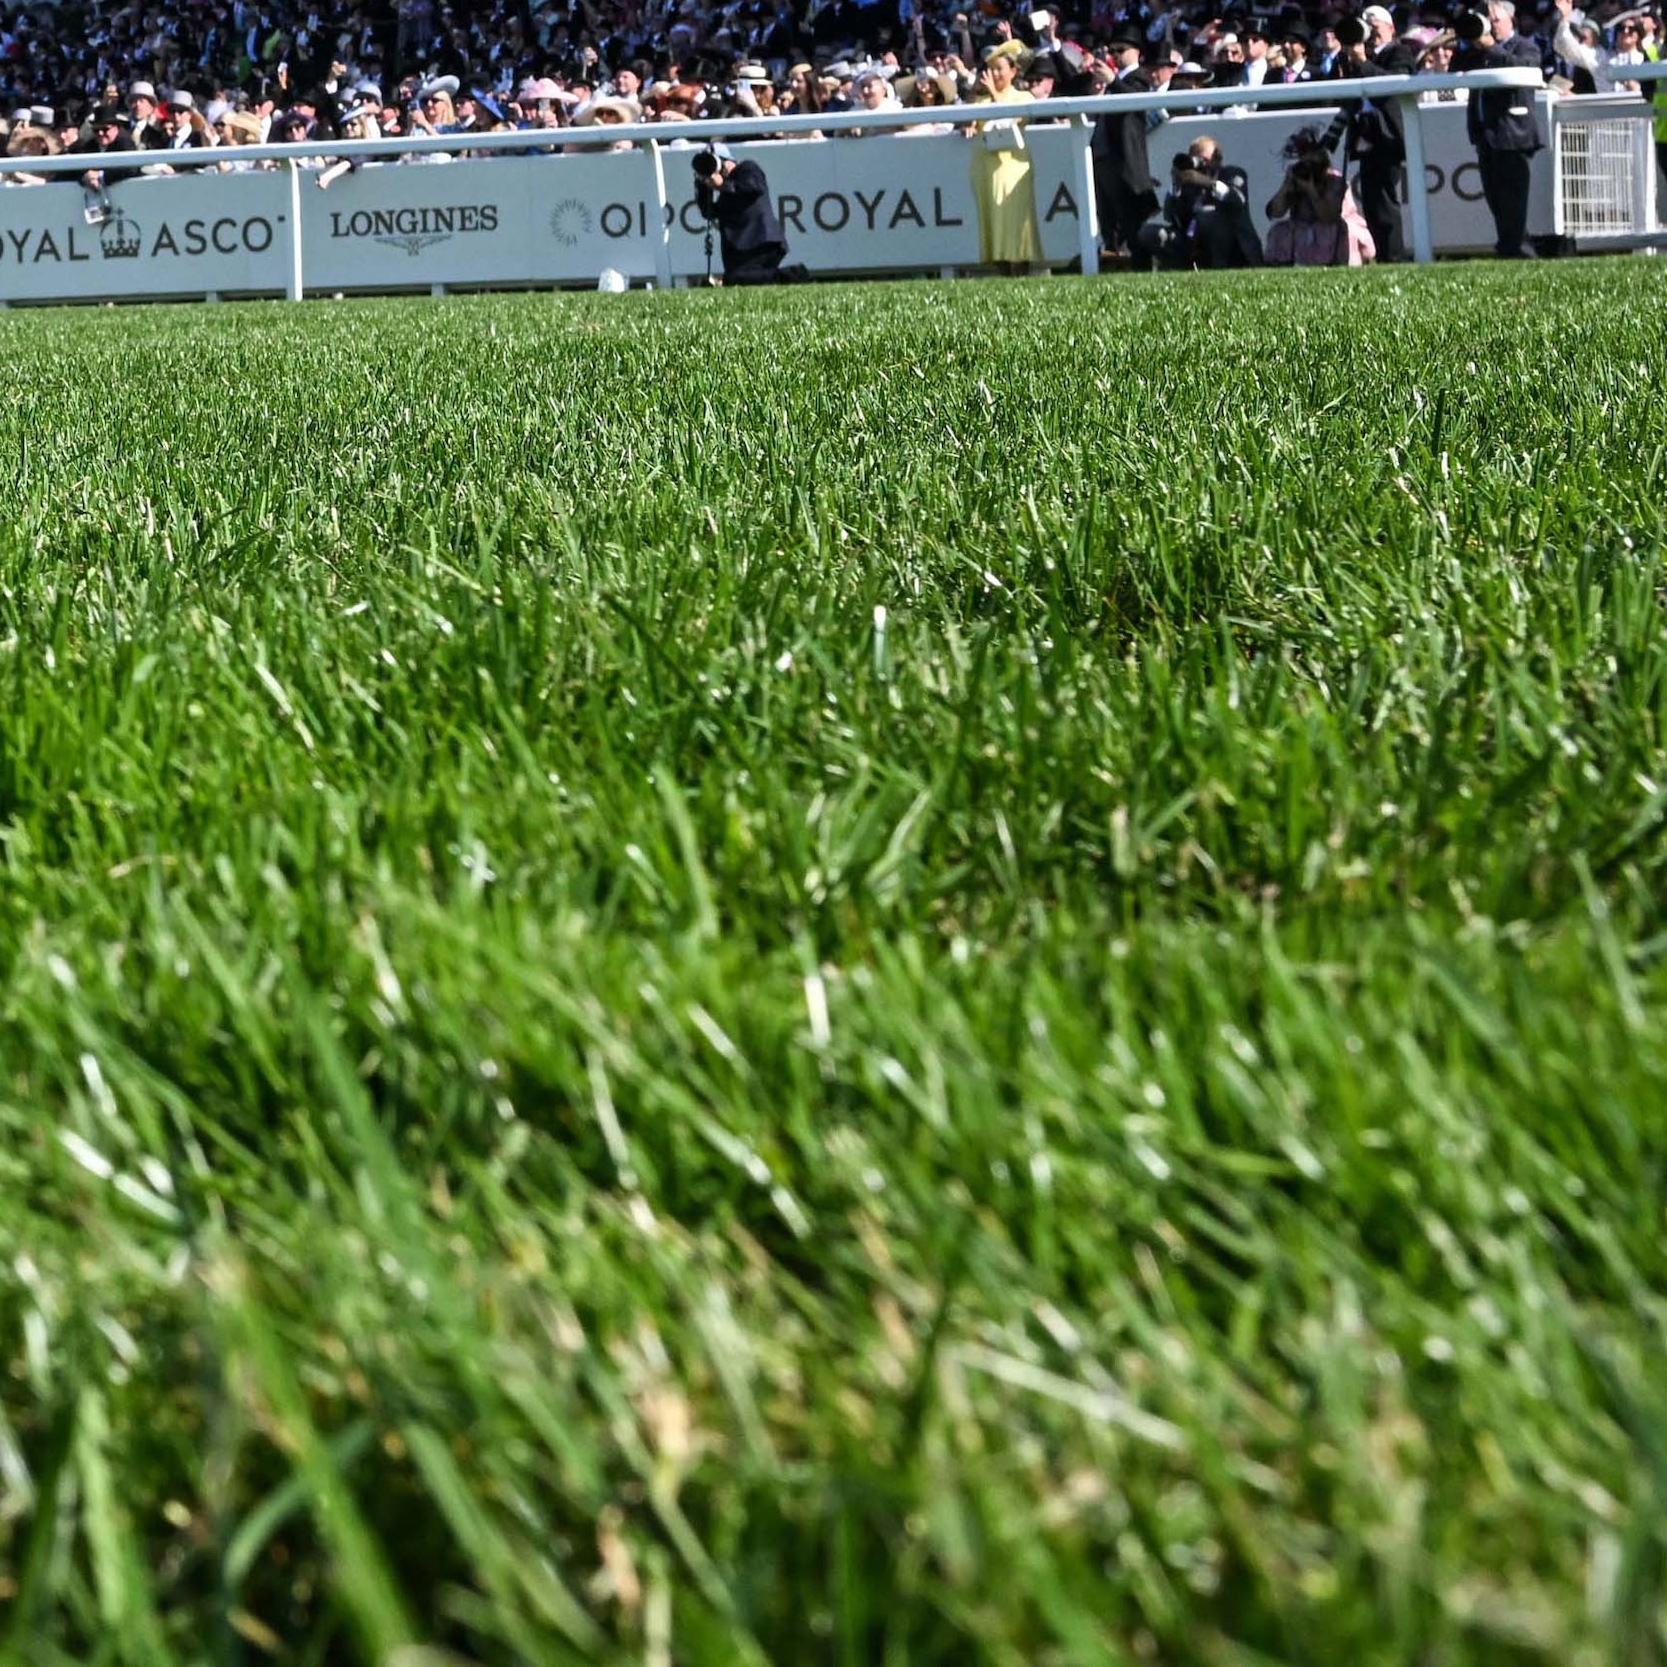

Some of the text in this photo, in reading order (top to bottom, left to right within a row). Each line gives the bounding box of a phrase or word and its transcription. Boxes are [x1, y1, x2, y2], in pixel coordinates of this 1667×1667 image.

[330, 205, 498, 237] LONGINES
[778, 187, 963, 233] ROYAL
[151, 215, 286, 257] ASCO
